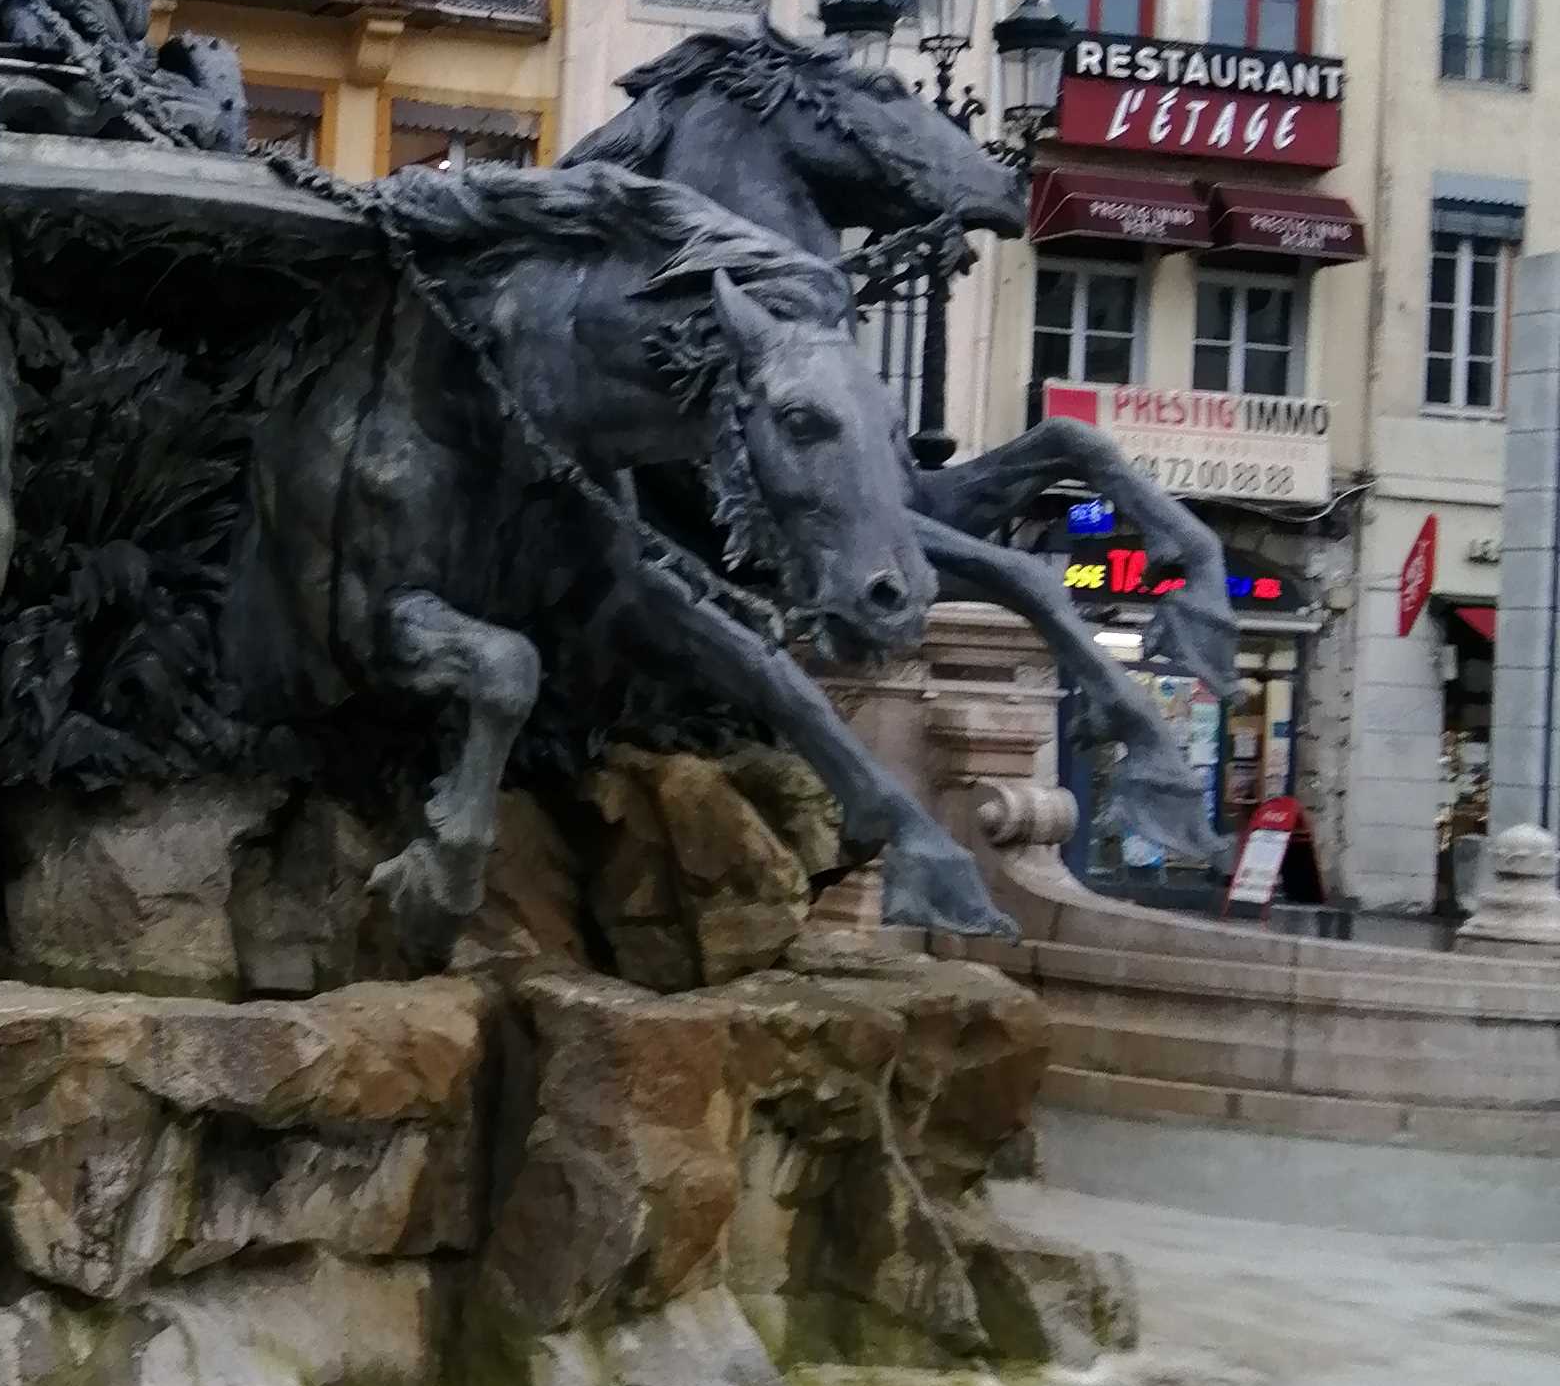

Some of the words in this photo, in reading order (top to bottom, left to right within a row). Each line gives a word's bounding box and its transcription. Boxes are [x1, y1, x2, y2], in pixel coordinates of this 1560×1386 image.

[1076, 41, 1343, 100] RESTAURANT
[1164, 457, 1194, 488] 72
[1197, 459, 1229, 491] 00
[1231, 462, 1262, 493] 88
[1264, 464, 1296, 496] 88
